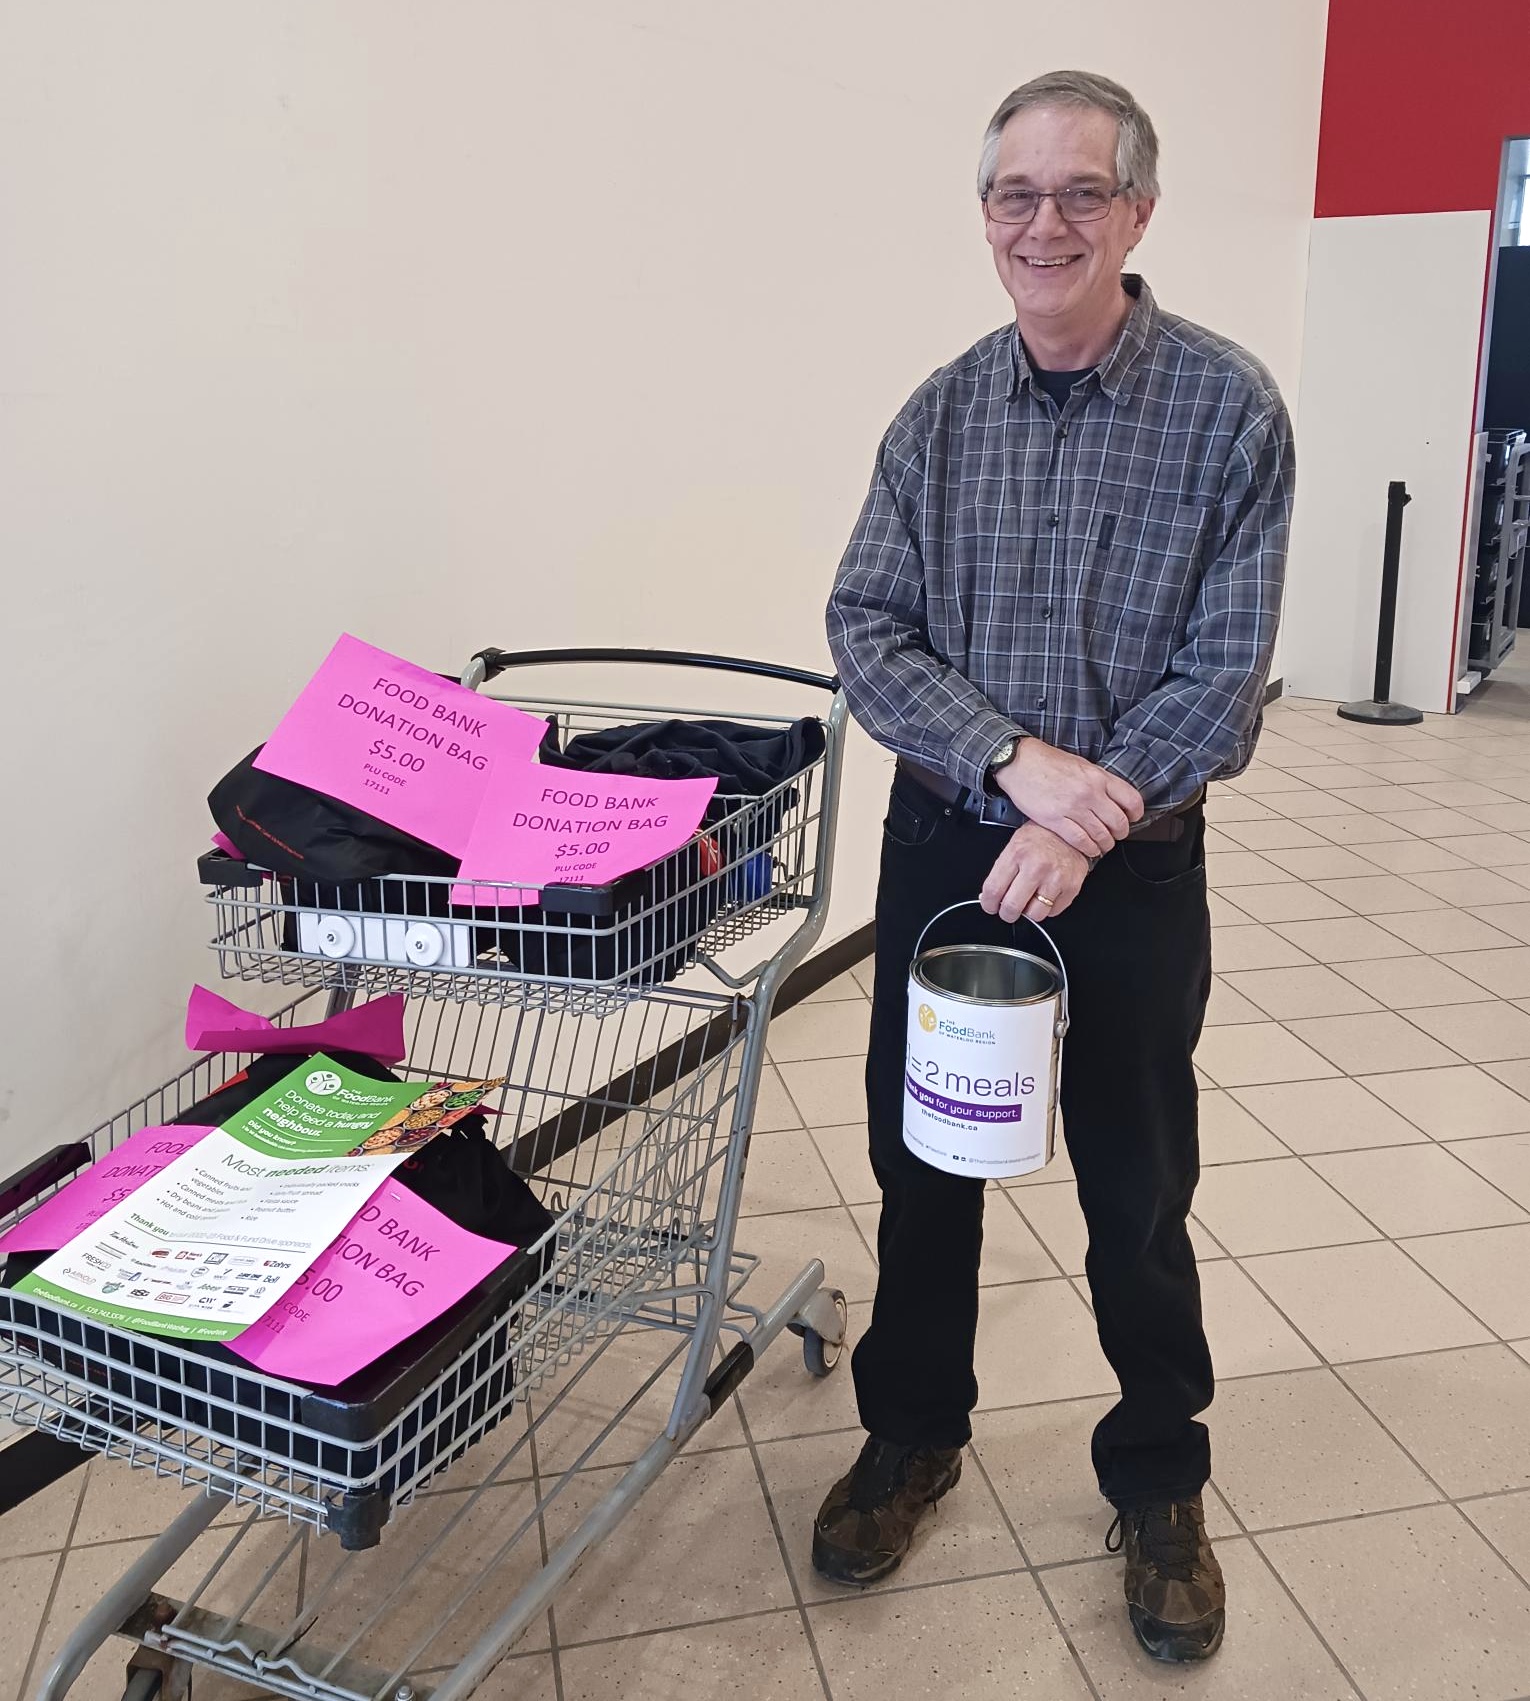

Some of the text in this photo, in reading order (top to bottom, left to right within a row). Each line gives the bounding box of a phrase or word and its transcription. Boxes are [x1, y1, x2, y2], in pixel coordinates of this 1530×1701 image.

[372, 677, 487, 738] FOOD BANK
[337, 693, 488, 771] DONATION BAG
[368, 739, 425, 772] $5.00
[363, 763, 407, 787] PLU CODE
[362, 778, 390, 795] 17111
[541, 788, 659, 810] FOOD BANK
[512, 813, 669, 833] DONATION BAG
[554, 841, 610, 859] $5.00
[554, 862, 598, 873] PLU CODE
[938, 1020, 996, 1040] FoodBank
[946, 1034, 974, 1043] WATERLOO
[945, 1072, 1035, 1097] meals
[285, 1089, 382, 1121] Donate today and
[336, 1089, 395, 1104] FoodBank
[919, 1092, 934, 1105] you
[936, 1098, 948, 1110] for
[950, 1104, 973, 1115] your
[975, 1109, 1018, 1120] support.
[262, 1108, 323, 1137] neighbour.
[274, 1098, 299, 1117] help
[299, 1112, 324, 1127] feed
[333, 1121, 374, 1130] hungry
[921, 1108, 978, 1131] thefoodbank.ca
[247, 1119, 260, 1129] Did
[259, 1125, 273, 1138] you
[273, 1132, 297, 1146] know?
[102, 1164, 165, 1179] DONAT
[221, 1154, 266, 1178] Most
[265, 1164, 330, 1178] needed
[191, 1177, 224, 1196] vegetables
[198, 1169, 224, 1186] Canned
[170, 1191, 182, 1201] Dry
[182, 1198, 202, 1211] beans
[180, 1184, 206, 1200] Canned
[160, 1199, 174, 1210] Hot
[173, 1206, 186, 1216] and
[130, 1212, 154, 1229] Thank
[154, 1224, 169, 1236] you
[378, 1218, 441, 1262] BANK
[328, 1234, 425, 1297] TION BAG
[295, 1267, 343, 1303] 5.00
[283, 1302, 310, 1323] CODE
[262, 1315, 285, 1334] 7111
